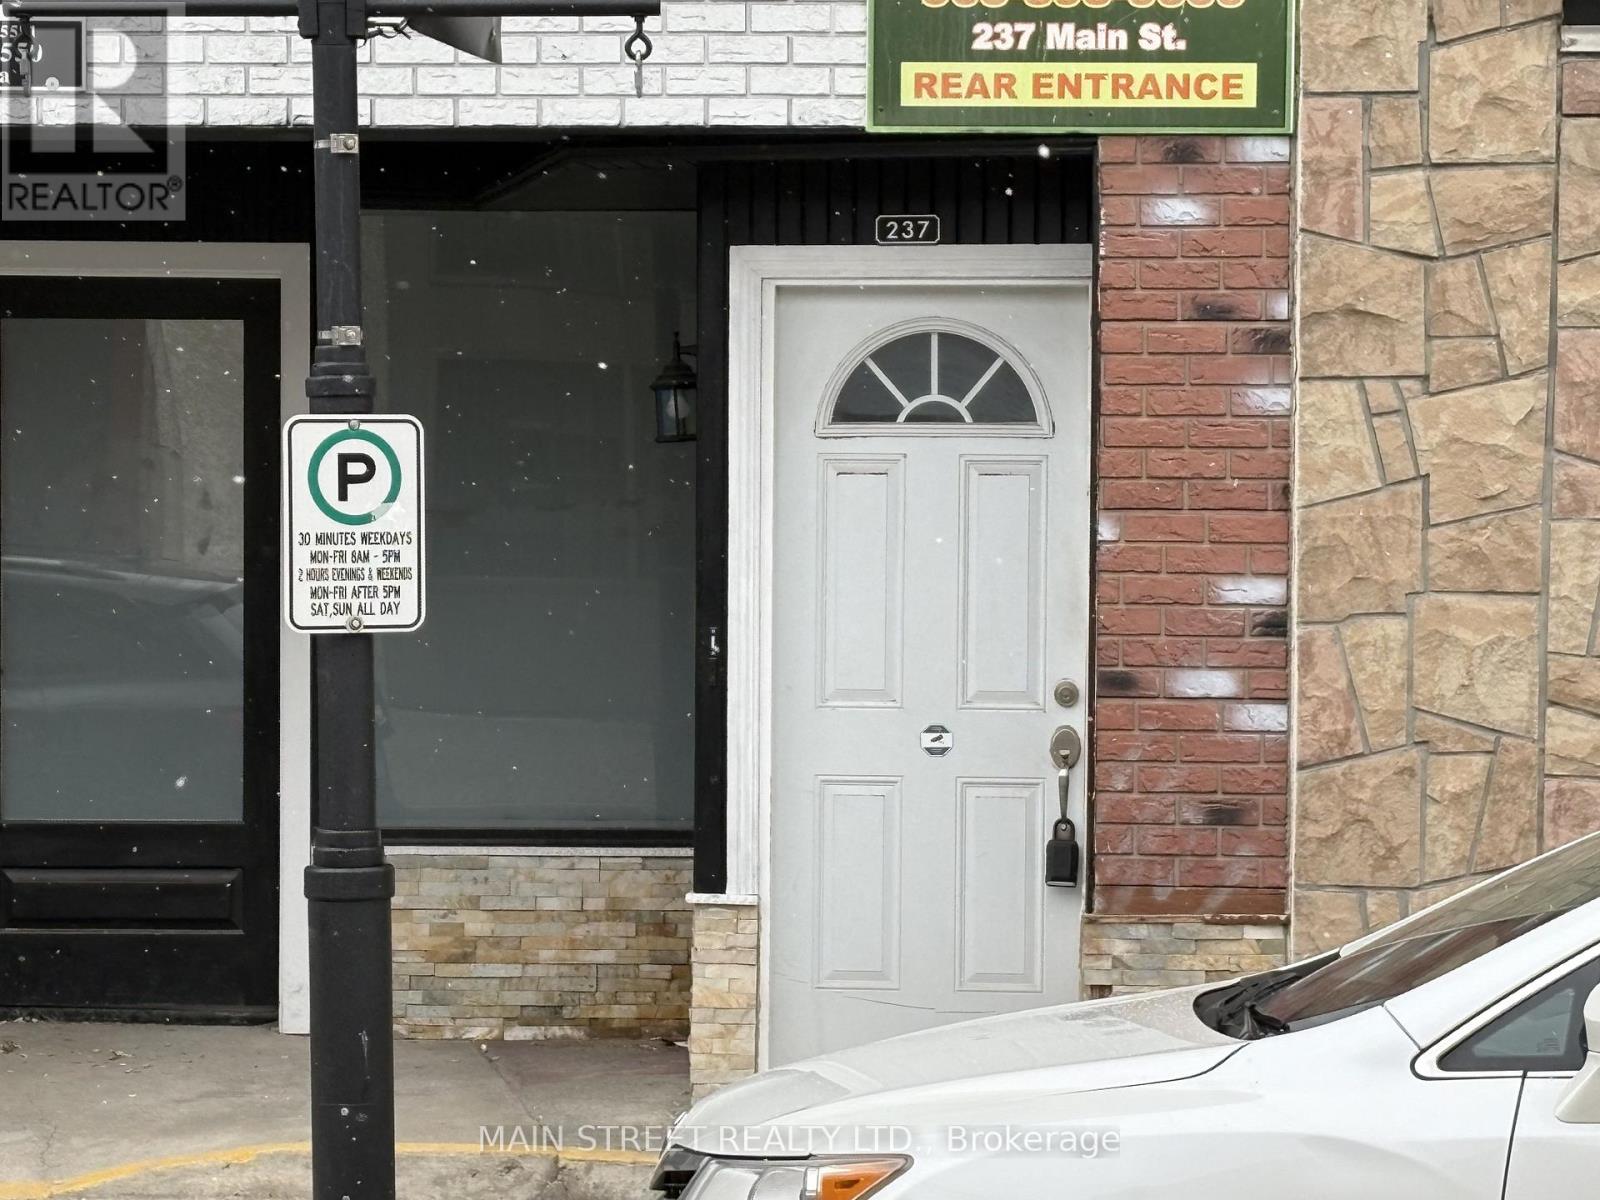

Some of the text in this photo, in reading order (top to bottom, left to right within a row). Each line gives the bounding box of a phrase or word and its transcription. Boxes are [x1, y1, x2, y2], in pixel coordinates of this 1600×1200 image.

[971, 22, 1187, 51] 237 Main St.
[914, 72, 1244, 100] REAR ENTRANCE
[886, 220, 930, 239] 237
[337, 452, 377, 502] P
[298, 531, 413, 546] 30 MINUTES WEEKDAYS
[309, 550, 347, 564] MON-FRI
[351, 550, 370, 564] 8AM
[382, 549, 401, 563] 5PM
[297, 567, 413, 582] 2 HOURS EVENINGS & WEEKENDS
[309, 585, 401, 599] MON-FRI AFTER 5PM
[310, 601, 401, 618] SAT,SUN ALL DAY
